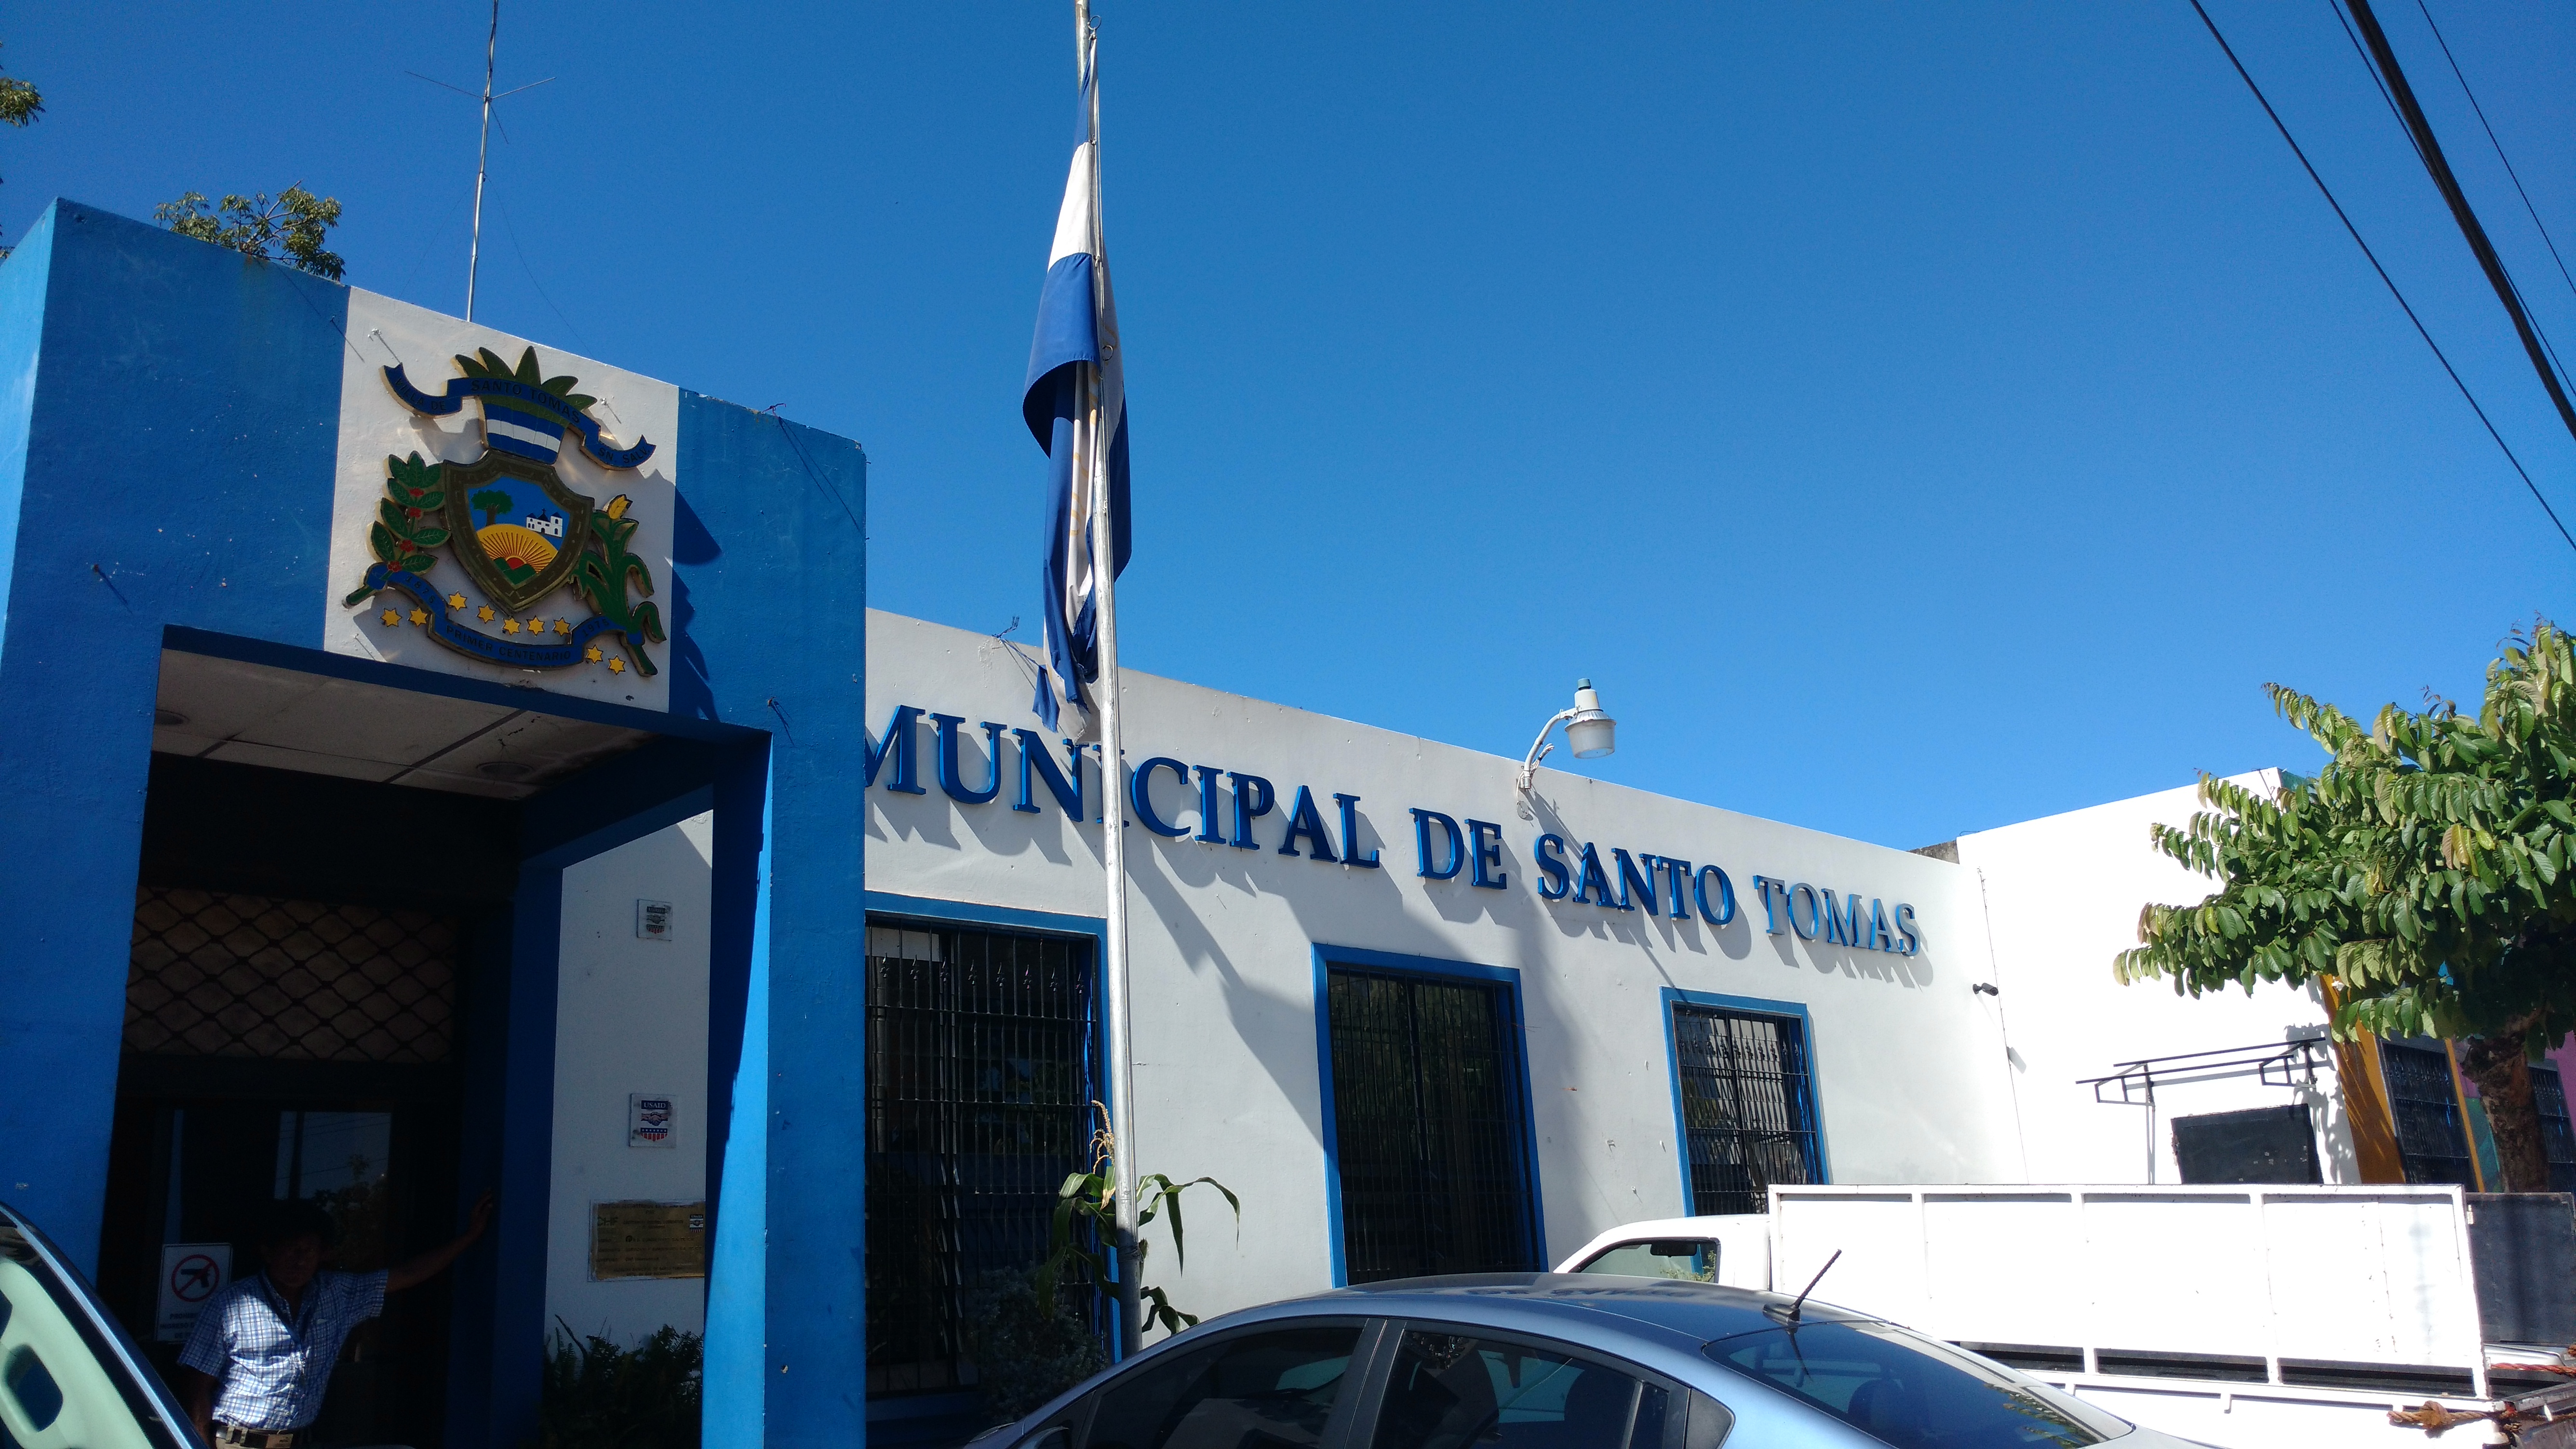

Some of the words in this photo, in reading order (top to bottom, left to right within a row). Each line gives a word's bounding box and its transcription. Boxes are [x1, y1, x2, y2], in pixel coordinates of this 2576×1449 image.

[394, 377, 425, 407] VILLA
[431, 401, 446, 410] DE
[470, 379, 522, 395] SANTO
[529, 388, 580, 424] TOMAS
[622, 446, 650, 463] SALV.
[404, 576, 435, 603] 1875
[446, 625, 493, 651] PRIMER
[499, 646, 571, 661] CENTENARIO
[582, 618, 610, 636] 1975
[1409, 807, 1507, 890] DE
[1534, 833, 1736, 926] SANTO
[1753, 874, 1922, 958] TOMAS
